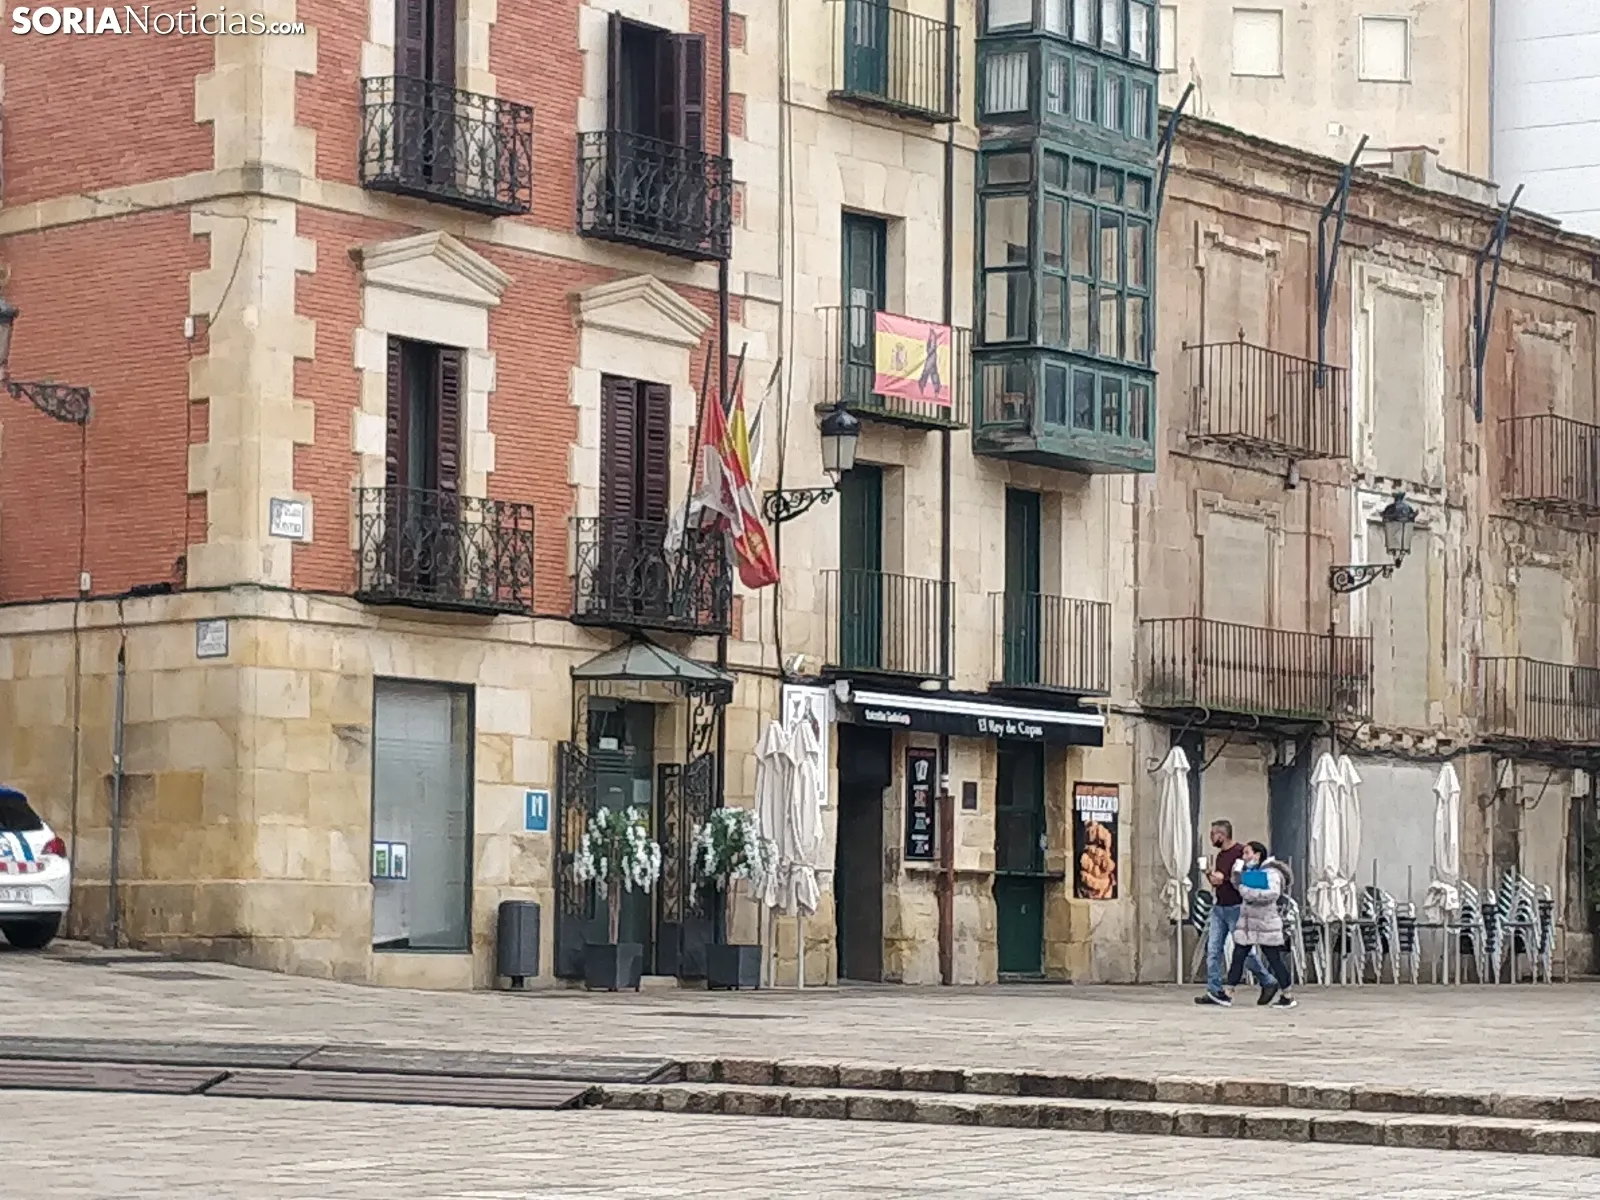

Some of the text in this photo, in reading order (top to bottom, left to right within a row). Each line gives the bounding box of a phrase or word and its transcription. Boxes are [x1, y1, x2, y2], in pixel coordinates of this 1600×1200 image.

[978, 718, 1043, 738] El Rey de Copas
